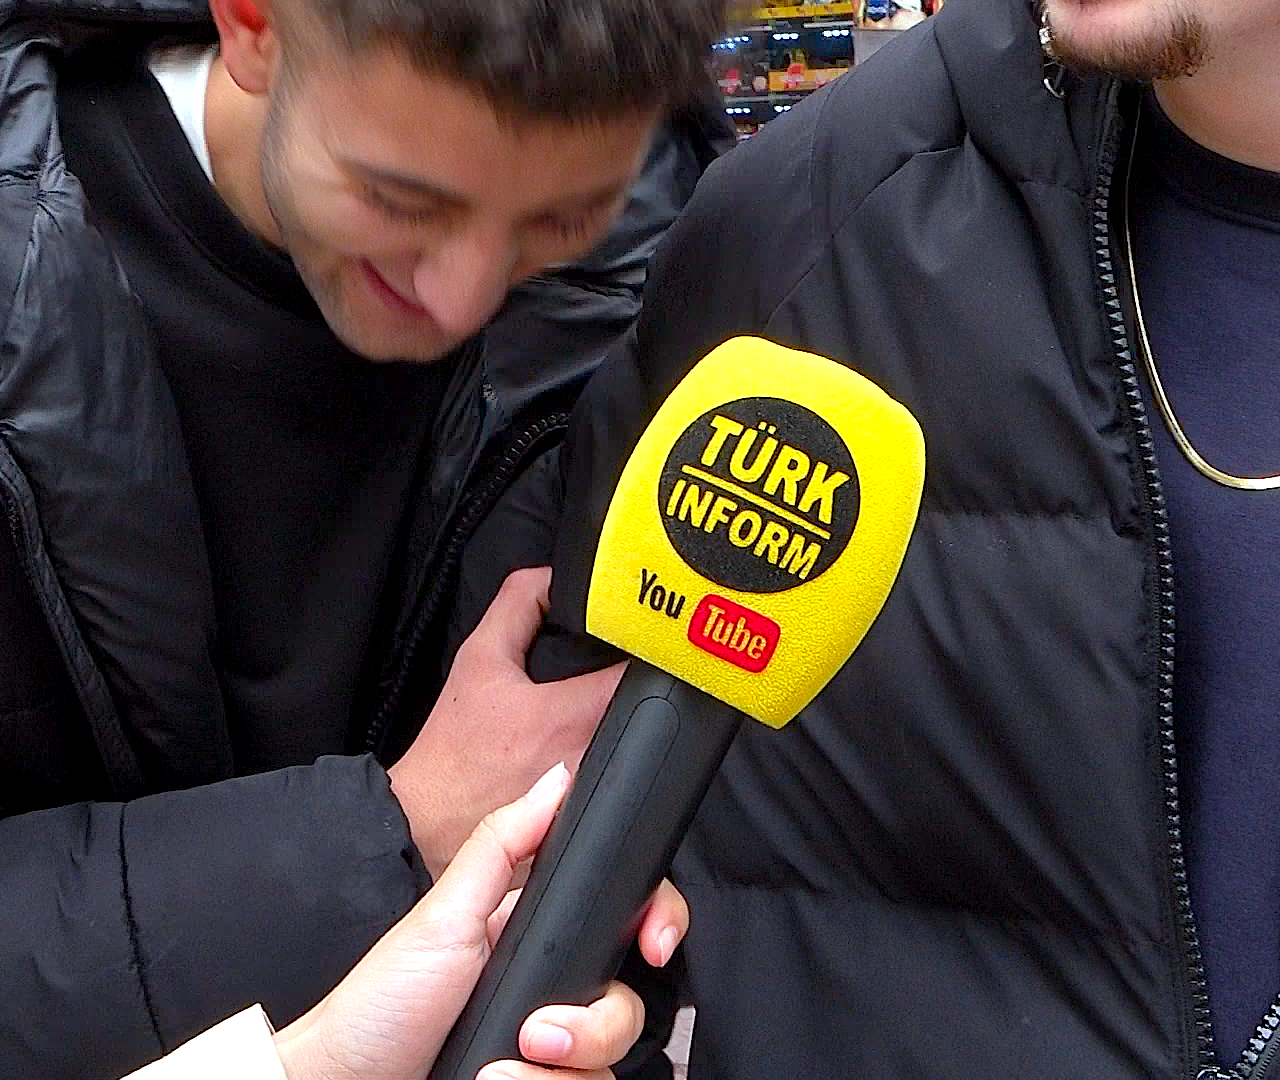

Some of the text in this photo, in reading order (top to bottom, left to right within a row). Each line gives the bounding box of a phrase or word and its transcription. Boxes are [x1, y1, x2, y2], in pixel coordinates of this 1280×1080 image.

[700, 414, 851, 525] TÜRK
[665, 479, 822, 580] INFORM
[637, 568, 767, 660] You Tube
